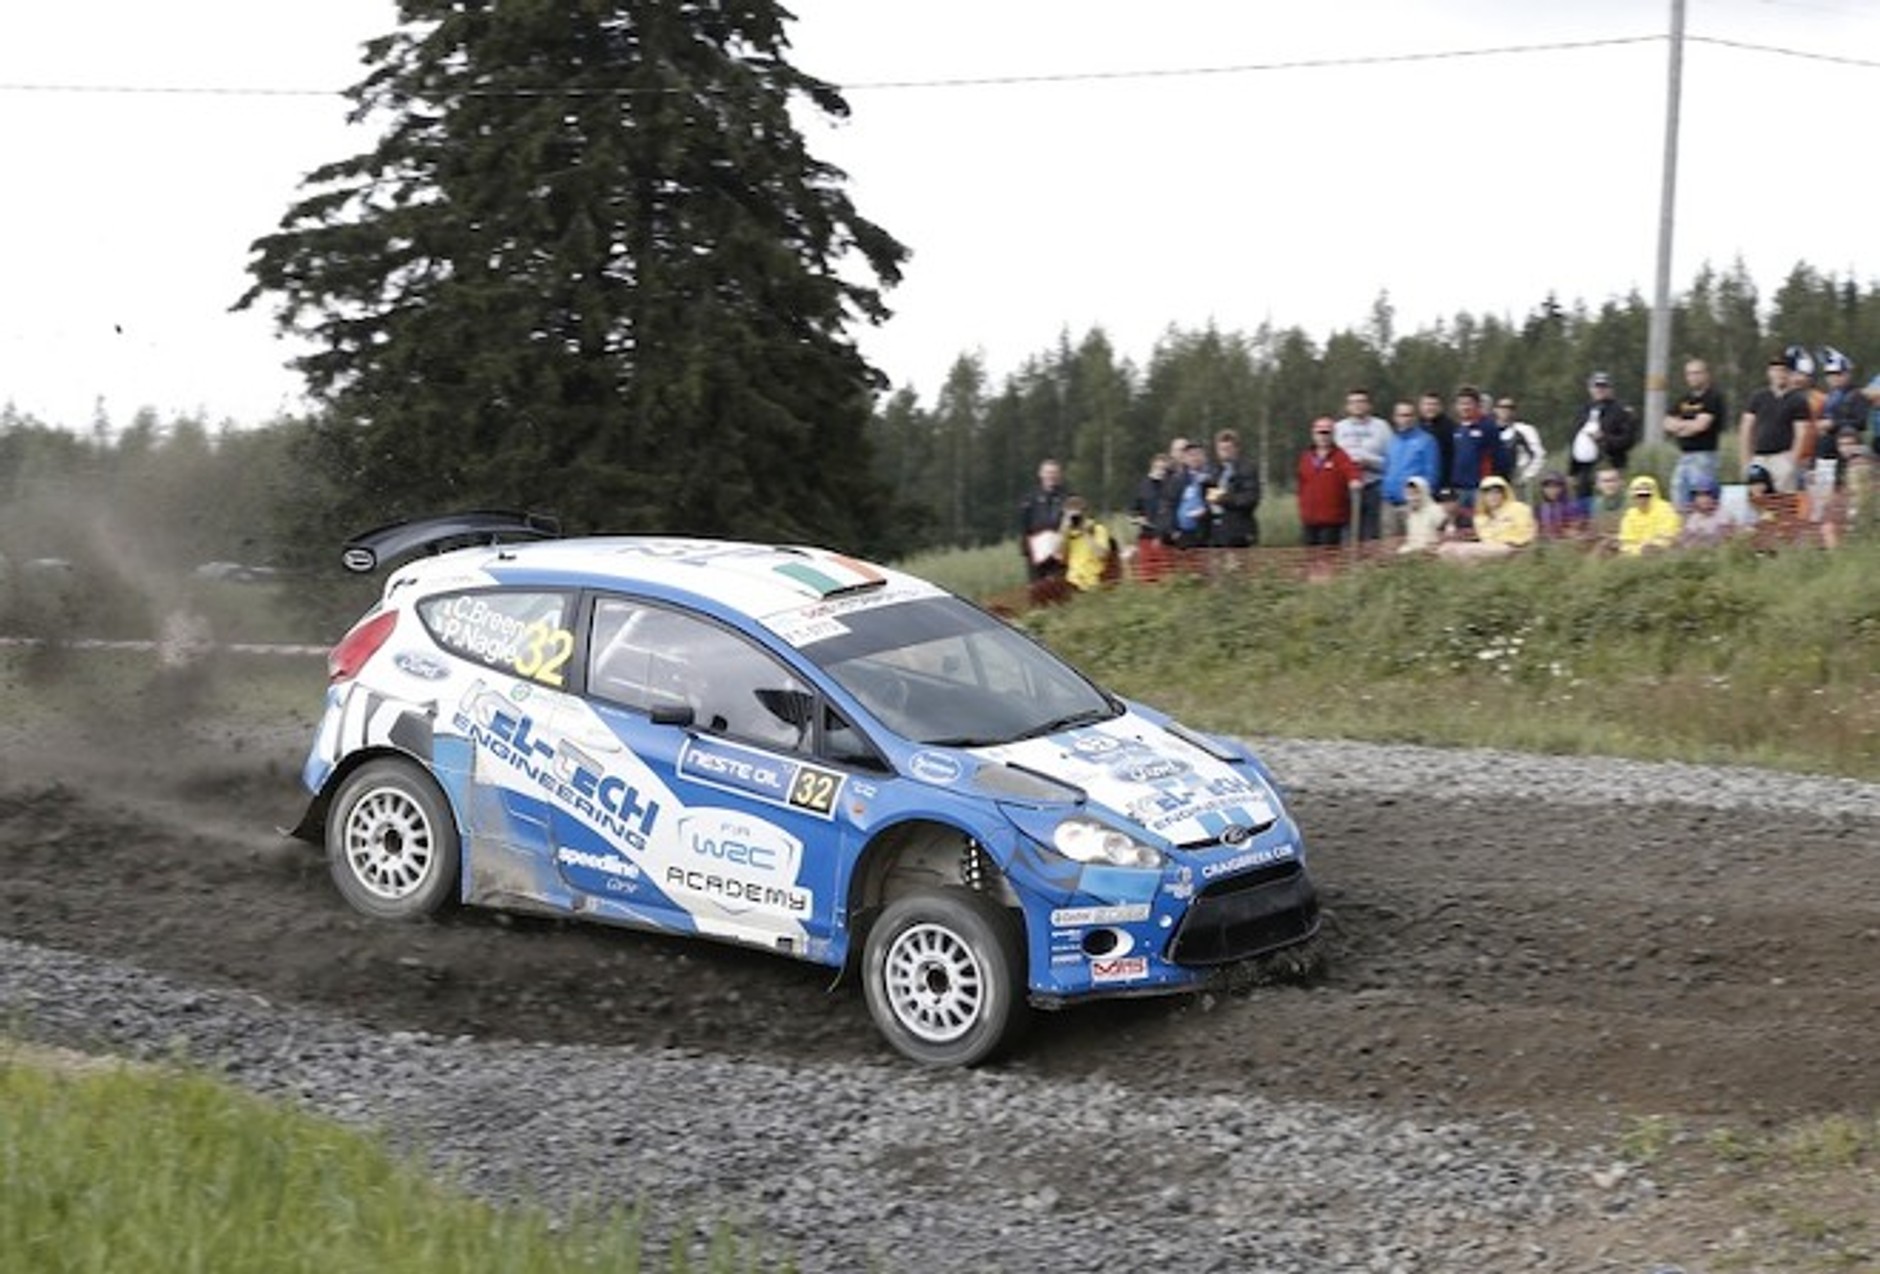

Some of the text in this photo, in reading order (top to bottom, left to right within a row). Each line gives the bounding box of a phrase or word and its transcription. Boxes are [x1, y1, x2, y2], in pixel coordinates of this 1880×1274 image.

[515, 620, 574, 686] 32
[452, 712, 648, 851] ENGINEERING
[753, 768, 781, 788] OIL
[796, 772, 834, 808] 32
[692, 835, 776, 871] WRC
[667, 867, 806, 911] ACADEMY
